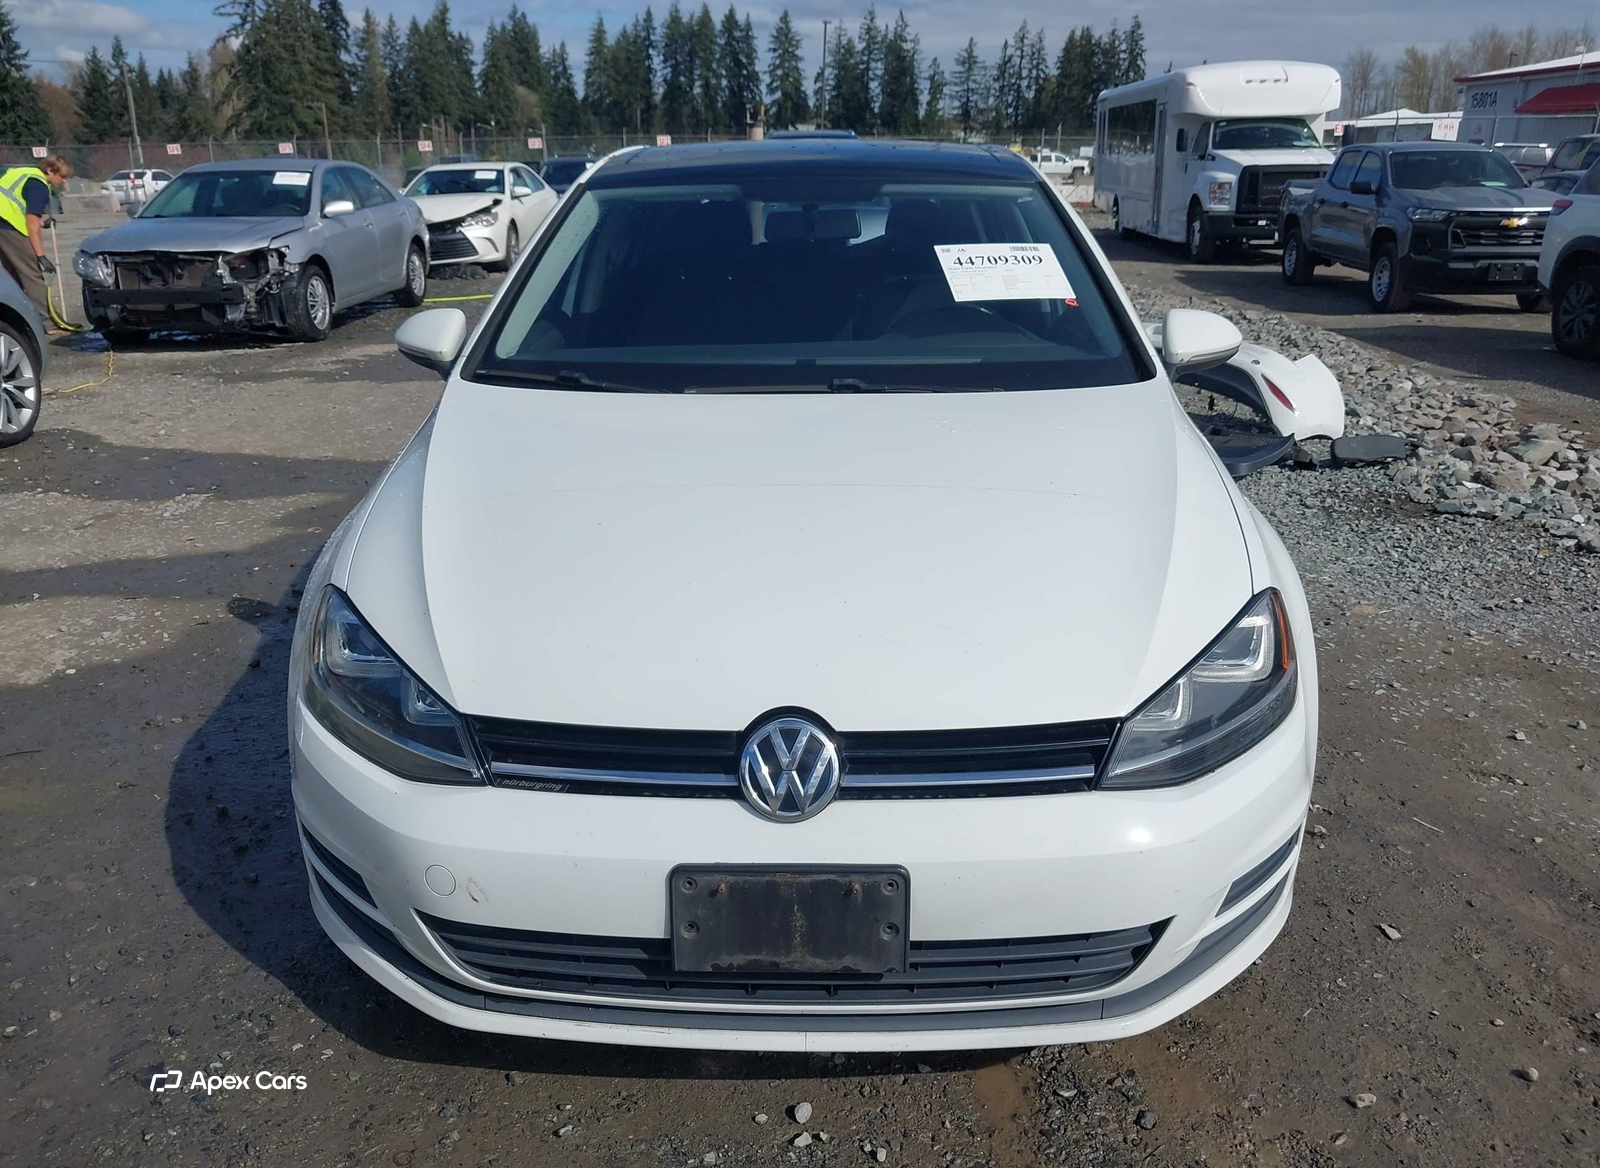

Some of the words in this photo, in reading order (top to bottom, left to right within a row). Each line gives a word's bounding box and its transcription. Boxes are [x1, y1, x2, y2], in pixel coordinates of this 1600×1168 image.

[1471, 91, 1498, 109] 15801A
[953, 254, 1043, 267] 44709309
[743, 721, 837, 818] VW
[502, 779, 563, 791] nürburgring
